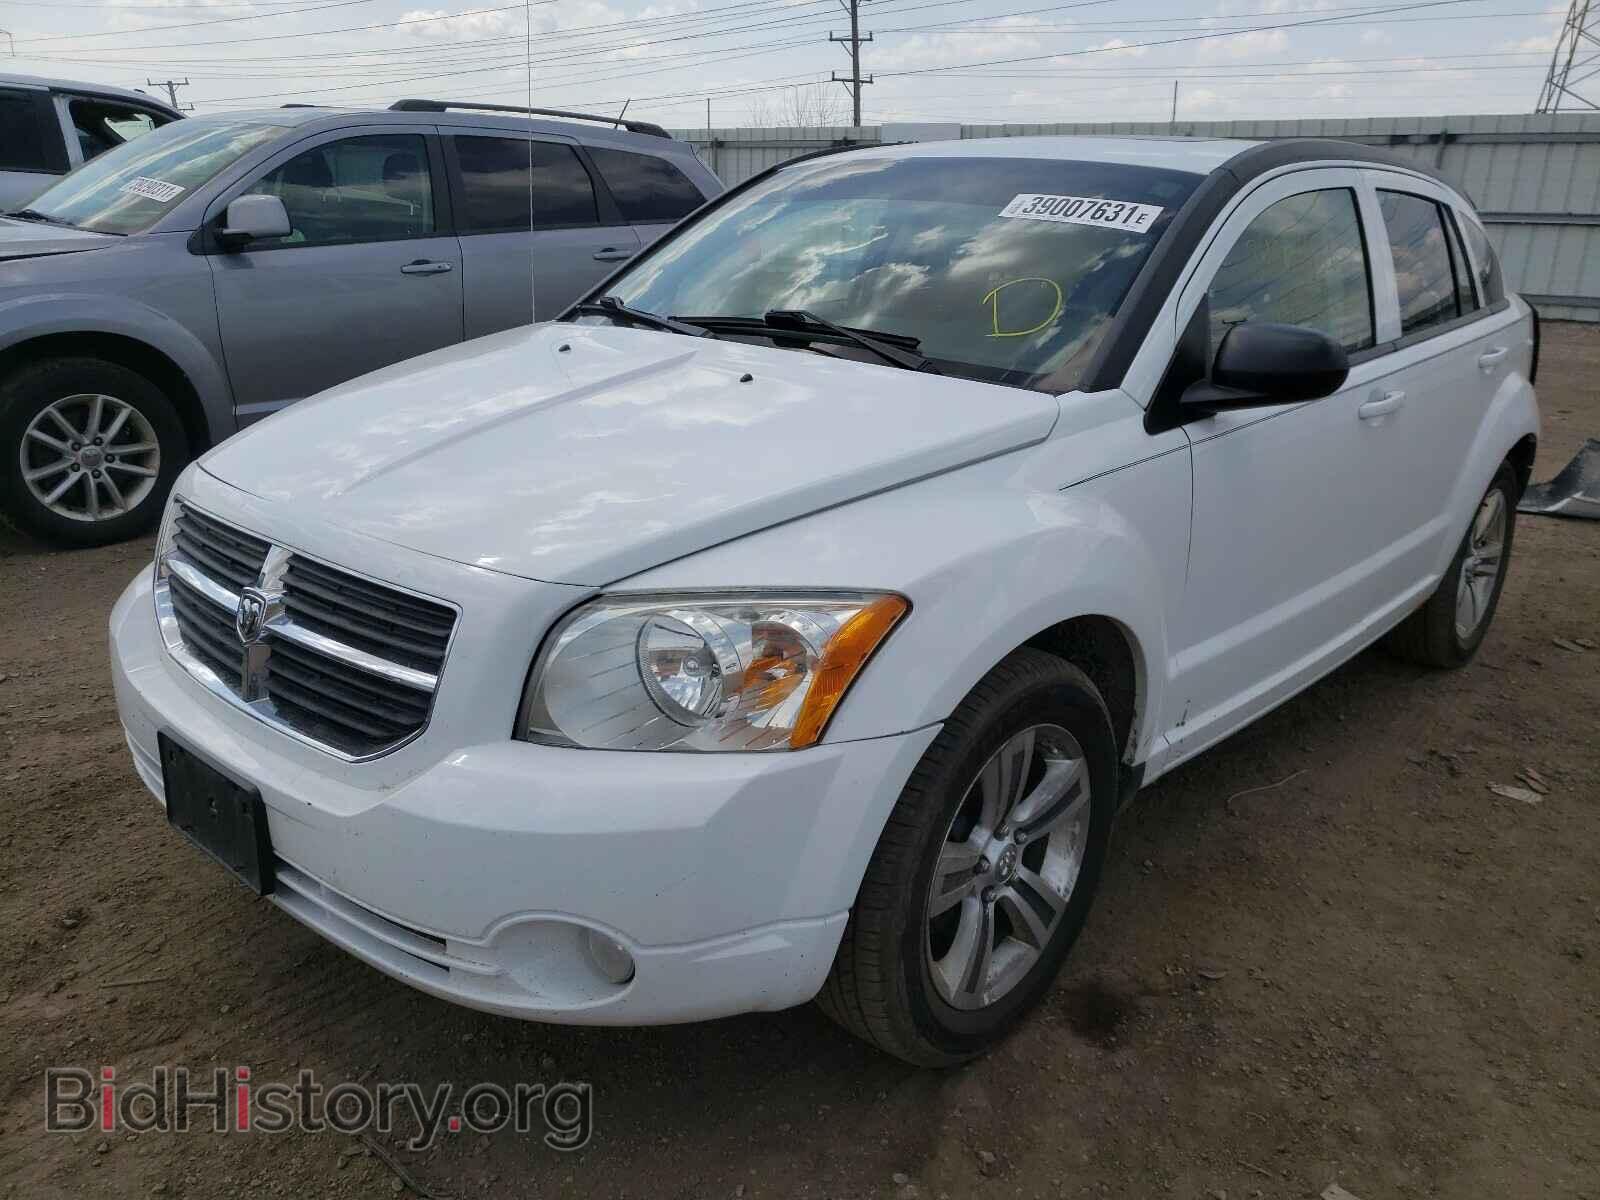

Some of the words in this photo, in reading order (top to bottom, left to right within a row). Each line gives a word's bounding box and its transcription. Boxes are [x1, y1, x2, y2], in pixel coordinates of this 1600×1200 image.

[1022, 196, 1139, 225] 39007631
[1135, 213, 1149, 225] E
[982, 277, 1063, 337] D
